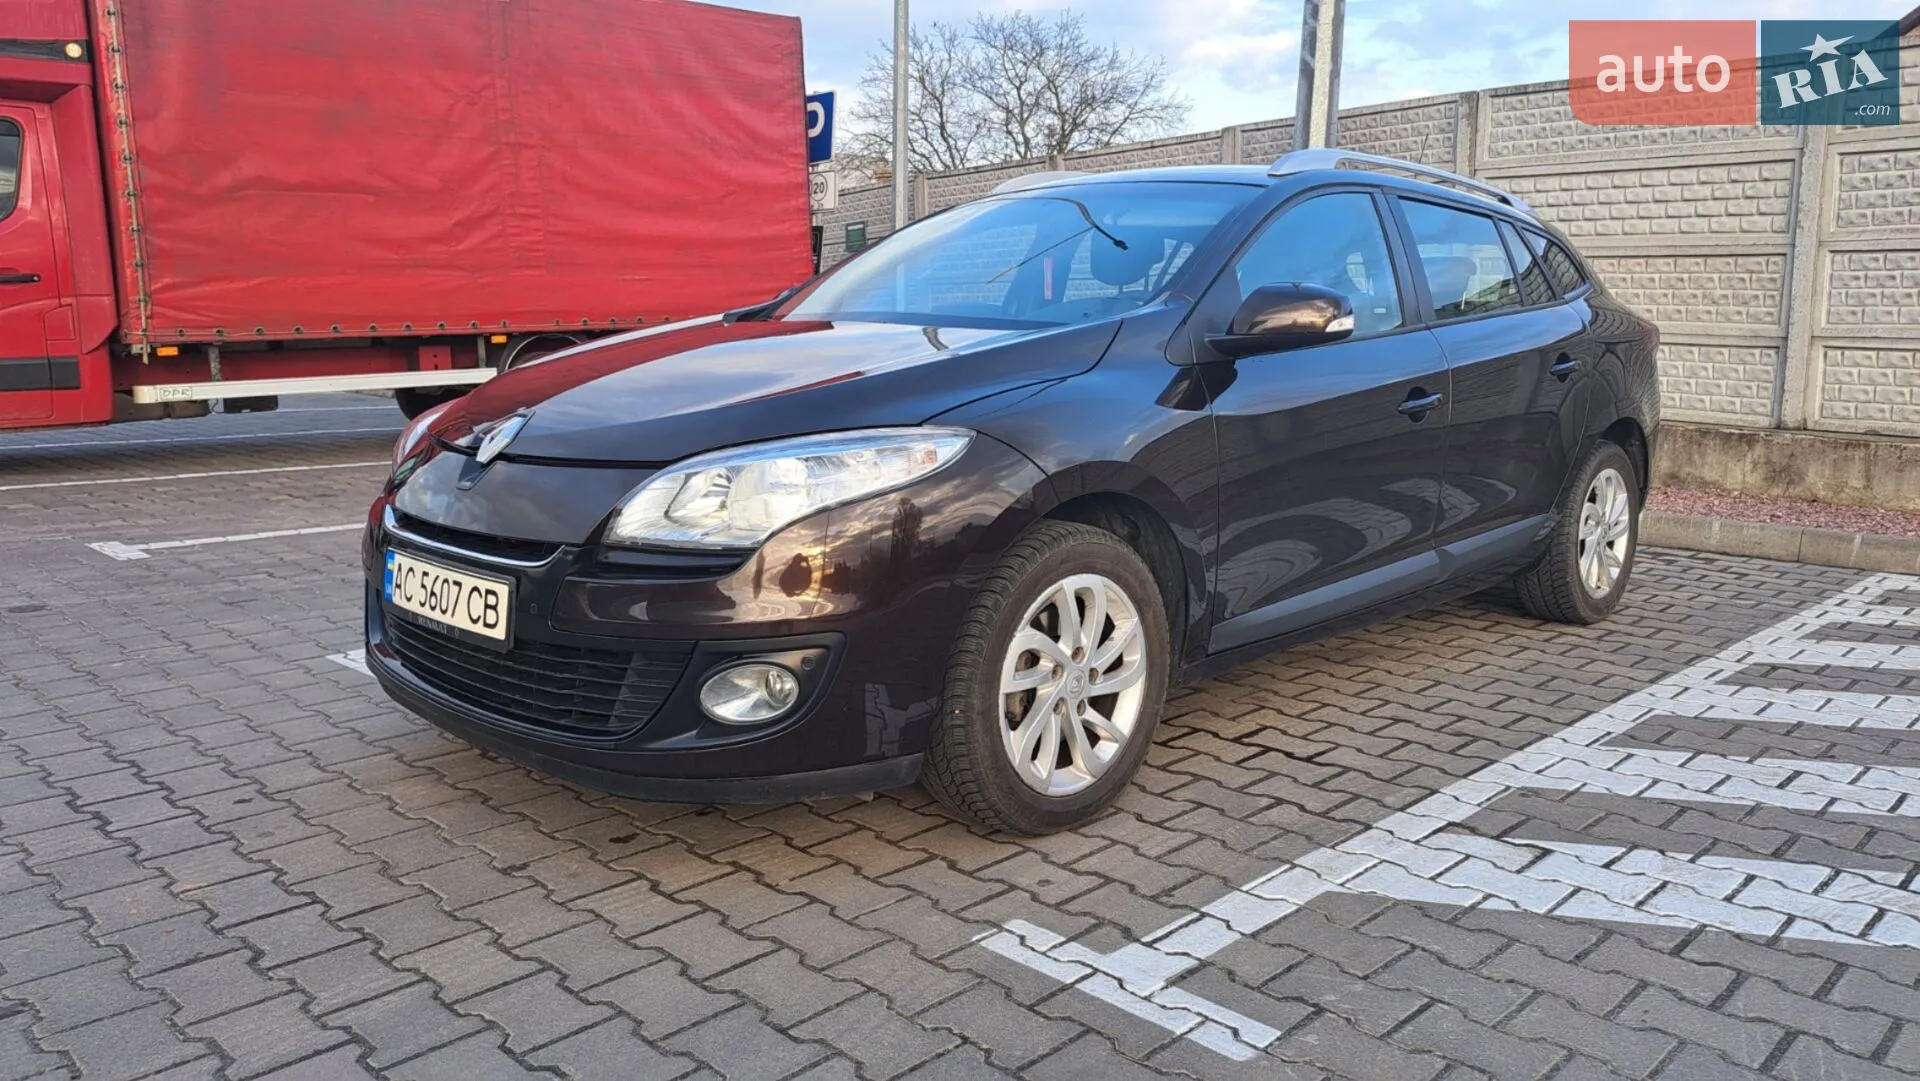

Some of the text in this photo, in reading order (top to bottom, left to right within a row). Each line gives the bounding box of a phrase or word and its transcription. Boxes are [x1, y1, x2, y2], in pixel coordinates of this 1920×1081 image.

[813, 181, 825, 194] 20
[394, 562, 500, 630] AC 5607 CB
